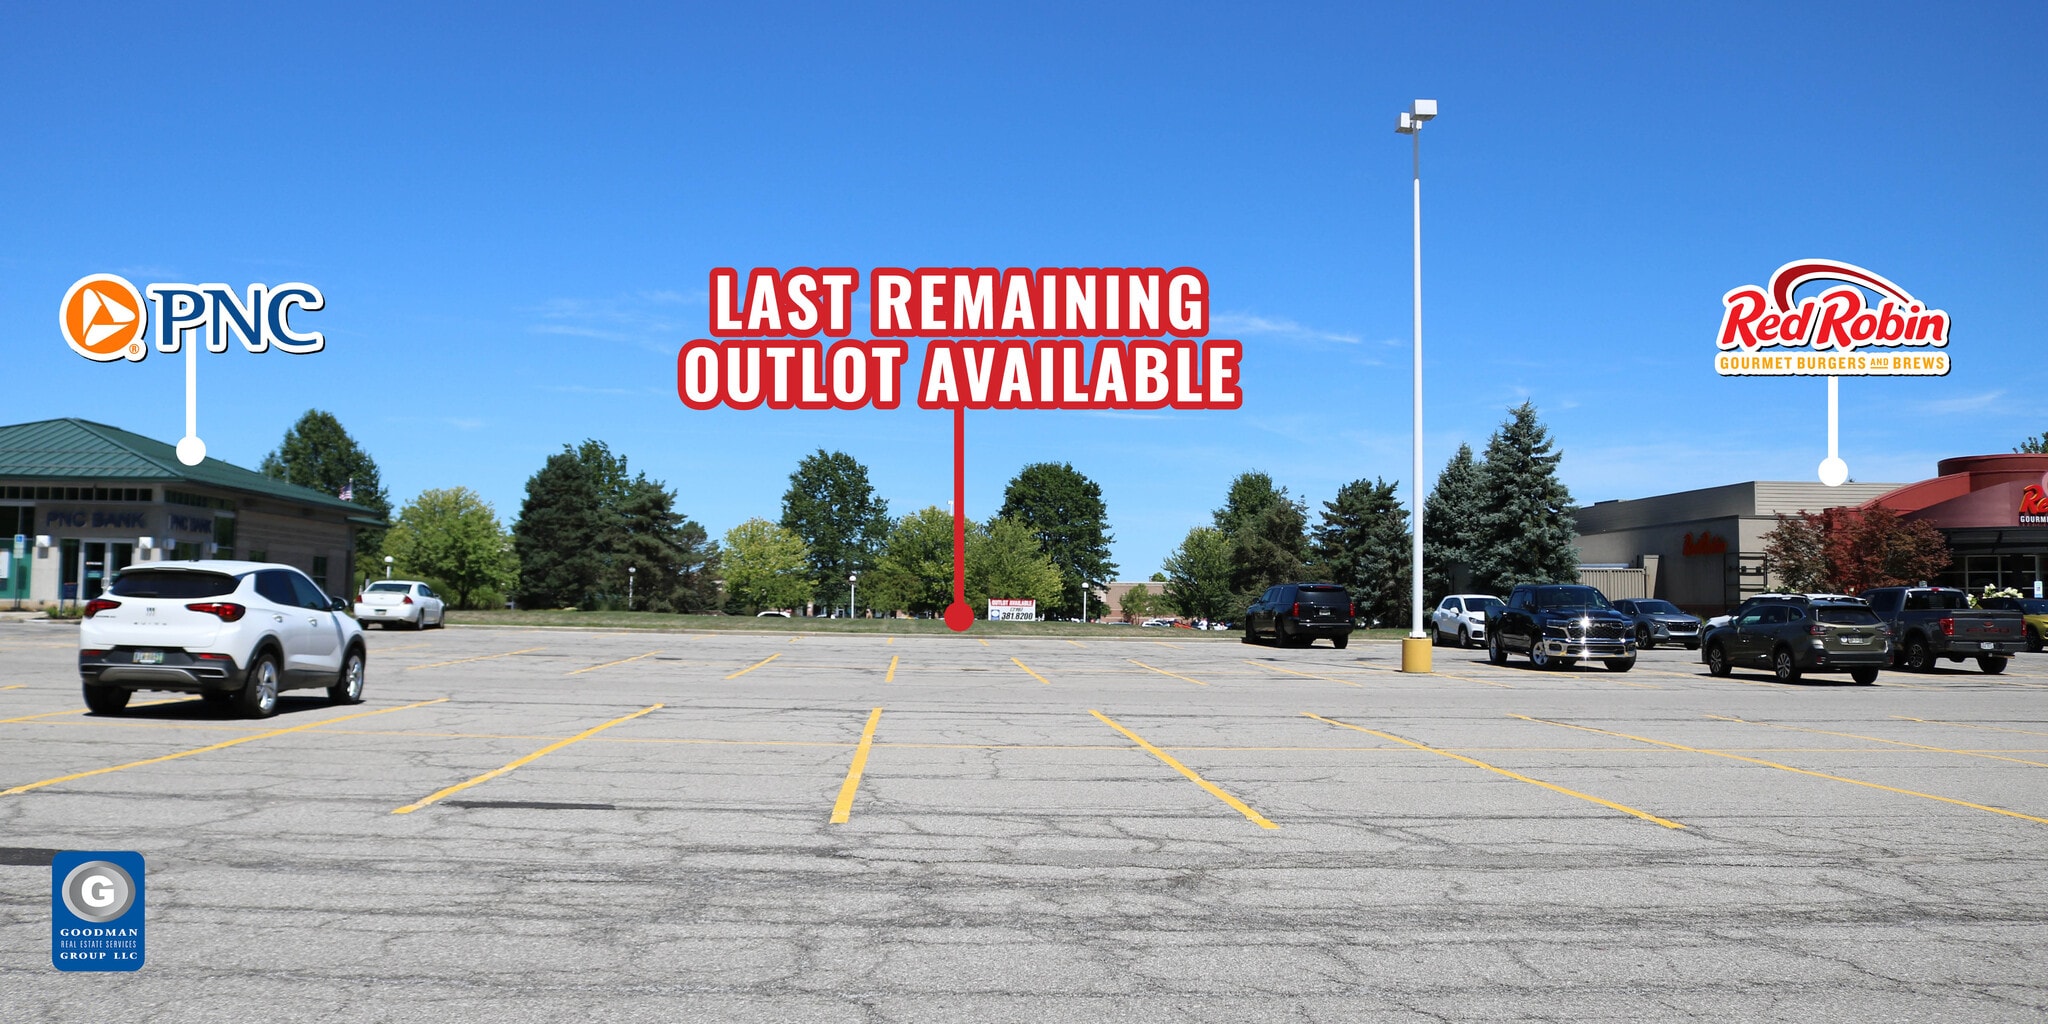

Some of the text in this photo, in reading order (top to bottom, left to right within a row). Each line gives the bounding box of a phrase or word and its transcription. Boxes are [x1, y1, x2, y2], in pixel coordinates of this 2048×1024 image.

[46, 511, 145, 528] PNC BANK
[2020, 515, 2048, 523] GOURM
